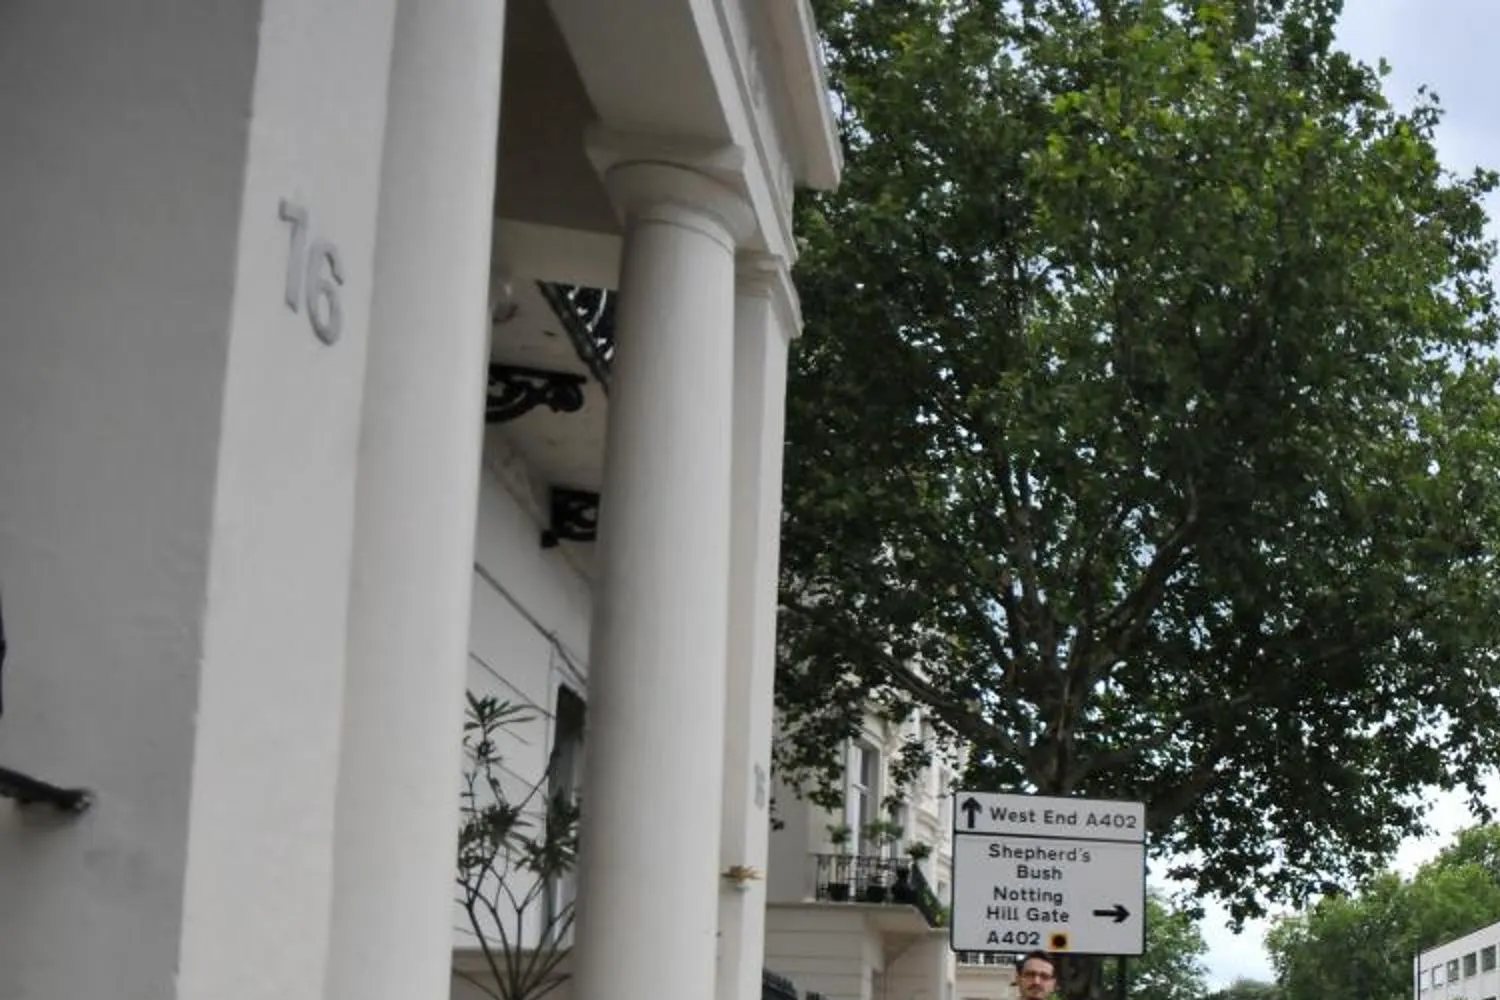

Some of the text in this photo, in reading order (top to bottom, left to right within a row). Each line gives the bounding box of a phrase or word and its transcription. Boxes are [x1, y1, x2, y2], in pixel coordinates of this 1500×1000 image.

[990, 806, 1137, 829] West End A402
[988, 843, 1092, 863] Shepherd's
[1016, 864, 1063, 880] Bush
[993, 886, 1063, 905] Notting
[986, 906, 1069, 923] Hill Gate
[986, 931, 1041, 946] A402
